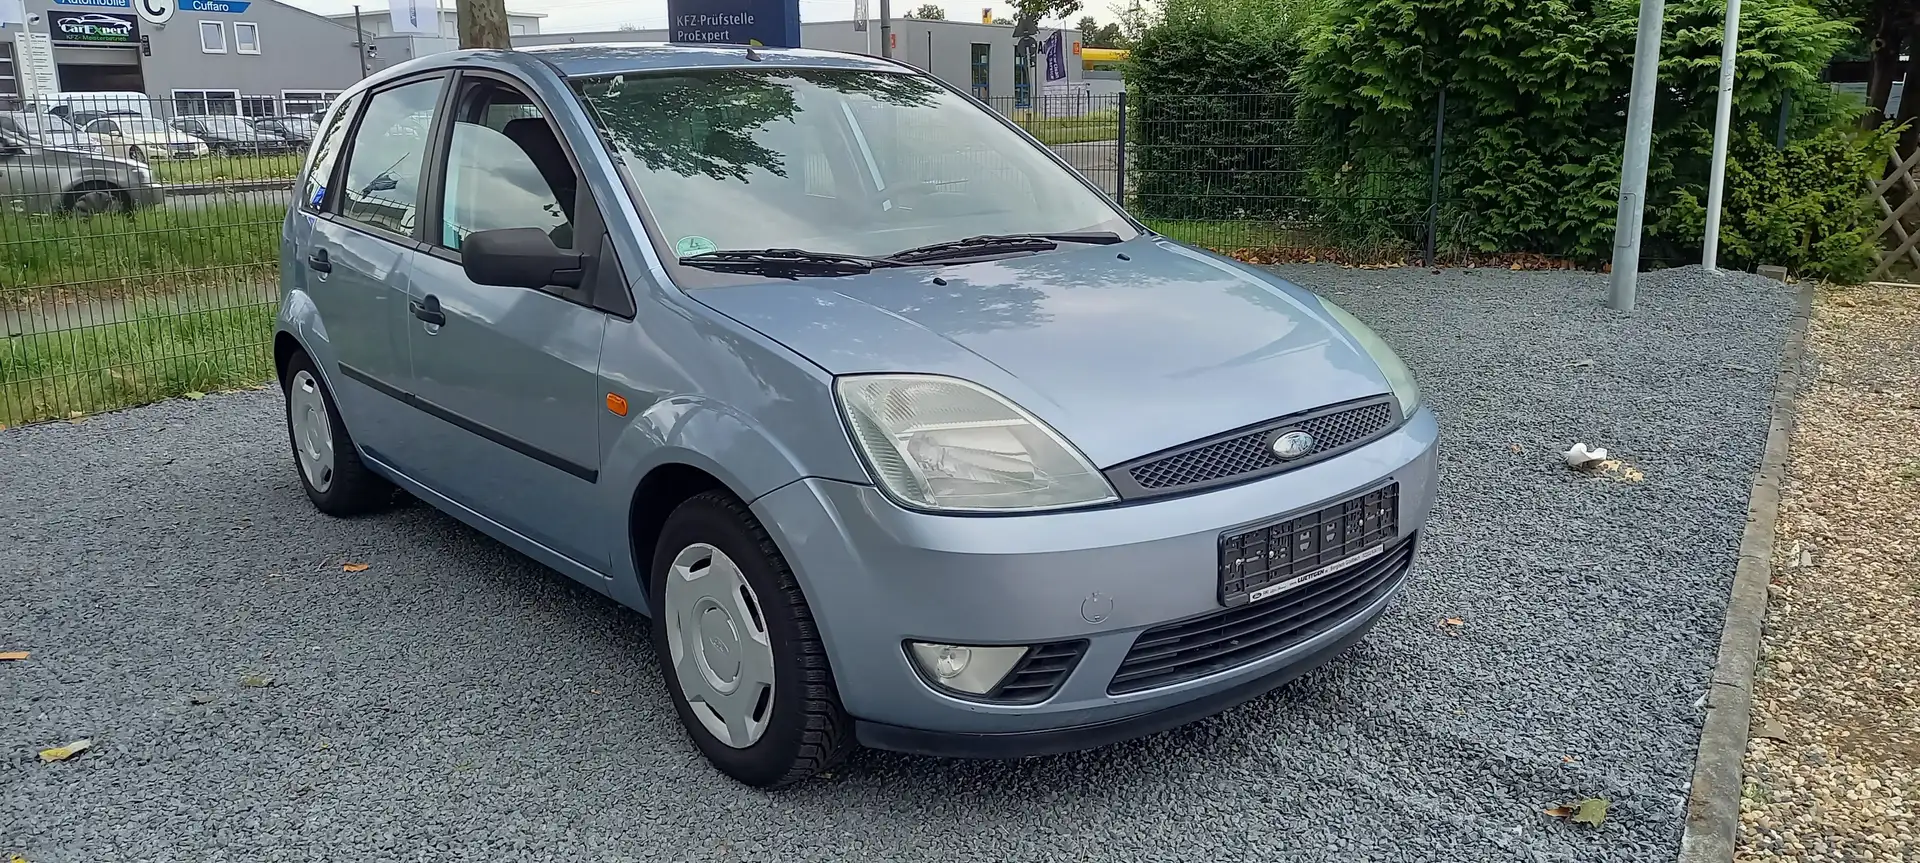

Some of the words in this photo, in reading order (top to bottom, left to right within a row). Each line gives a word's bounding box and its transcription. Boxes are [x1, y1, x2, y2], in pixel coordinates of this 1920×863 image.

[193, 0, 229, 11] Cuffaro
[60, 23, 129, 36] CarExpert
[677, 30, 730, 42] ProExpert
